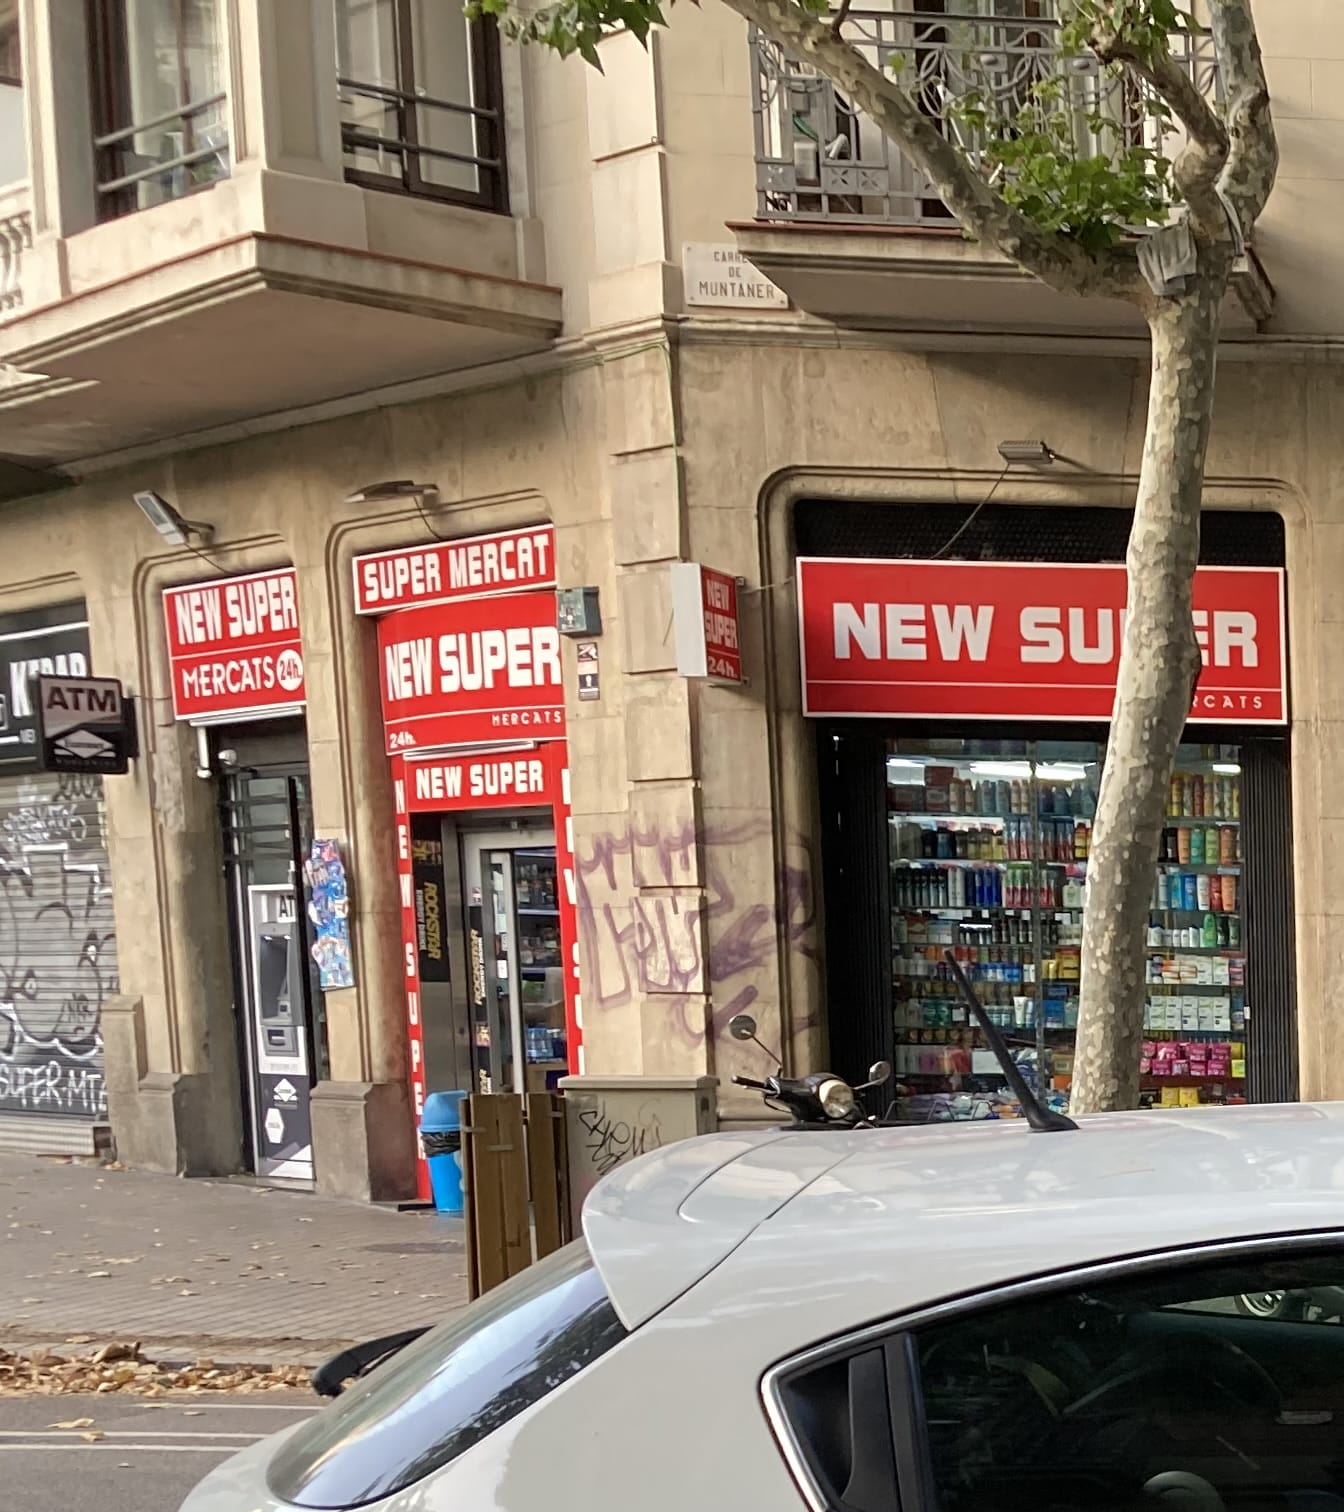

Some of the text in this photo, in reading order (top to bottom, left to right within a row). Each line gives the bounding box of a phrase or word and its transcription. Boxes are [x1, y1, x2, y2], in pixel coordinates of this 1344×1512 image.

[699, 281, 775, 299] MUNTANER
[728, 266, 742, 278] DE
[365, 533, 549, 601] SUPER MERCAT
[174, 576, 298, 645] NEW SUPER
[706, 580, 730, 610] NEW
[704, 613, 738, 648] SUPER
[833, 602, 1258, 668] NEW SUR
[182, 656, 301, 698] MERCATS 24h
[385, 637, 433, 701] NEW
[440, 626, 562, 693] SUPER
[47, 687, 117, 712] ATM
[492, 711, 562, 727] MERCATS
[416, 760, 544, 799] NEW SUPER
[280, 895, 296, 918] AT
[424, 881, 441, 960] ROCKSTAR
